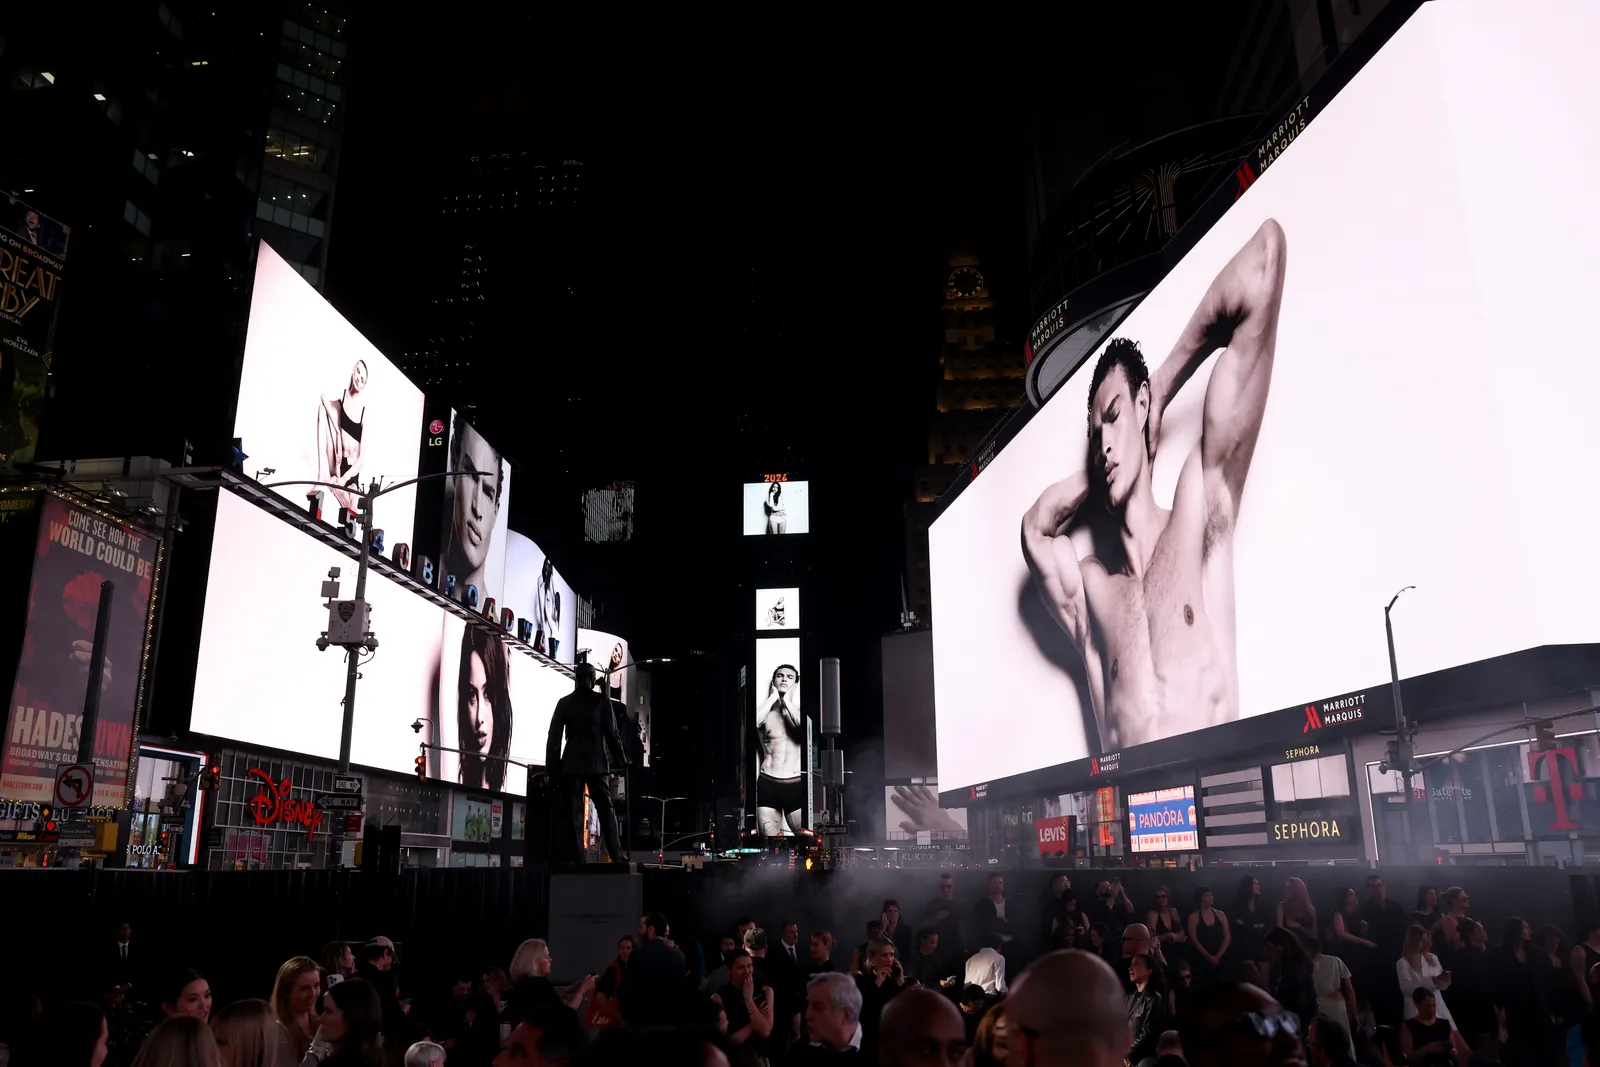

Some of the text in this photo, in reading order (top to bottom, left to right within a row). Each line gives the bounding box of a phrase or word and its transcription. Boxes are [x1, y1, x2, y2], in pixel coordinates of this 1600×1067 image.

[1258, 96, 1309, 158] MARRIOTT
[1260, 118, 1306, 173] MARQUIS
[8, 238, 22, 249] ON
[22, 245, 64, 271] BROADWAY
[1032, 299, 1068, 340] MARRIOTT
[16, 336, 28, 346] EVA
[1033, 317, 1064, 353] MARQUIS
[3, 337, 39, 357] NOBLEZADA
[428, 437, 443, 447] LG
[763, 473, 788, 483] 2026
[68, 510, 142, 553] COME SEE HOW THE
[50, 520, 152, 580] WORLD COULD BE
[415, 554, 562, 661] BROADWAY
[1323, 695, 1365, 712] MARRIOTT
[1325, 709, 1362, 725] MARQUIS
[10, 746, 61, 762] BROADWAY'S
[1285, 745, 1320, 759] SEPHORA
[1139, 809, 1184, 829] PANDORA
[1274, 820, 1341, 840] SEPHORA
[132, 845, 151, 855] POLO
